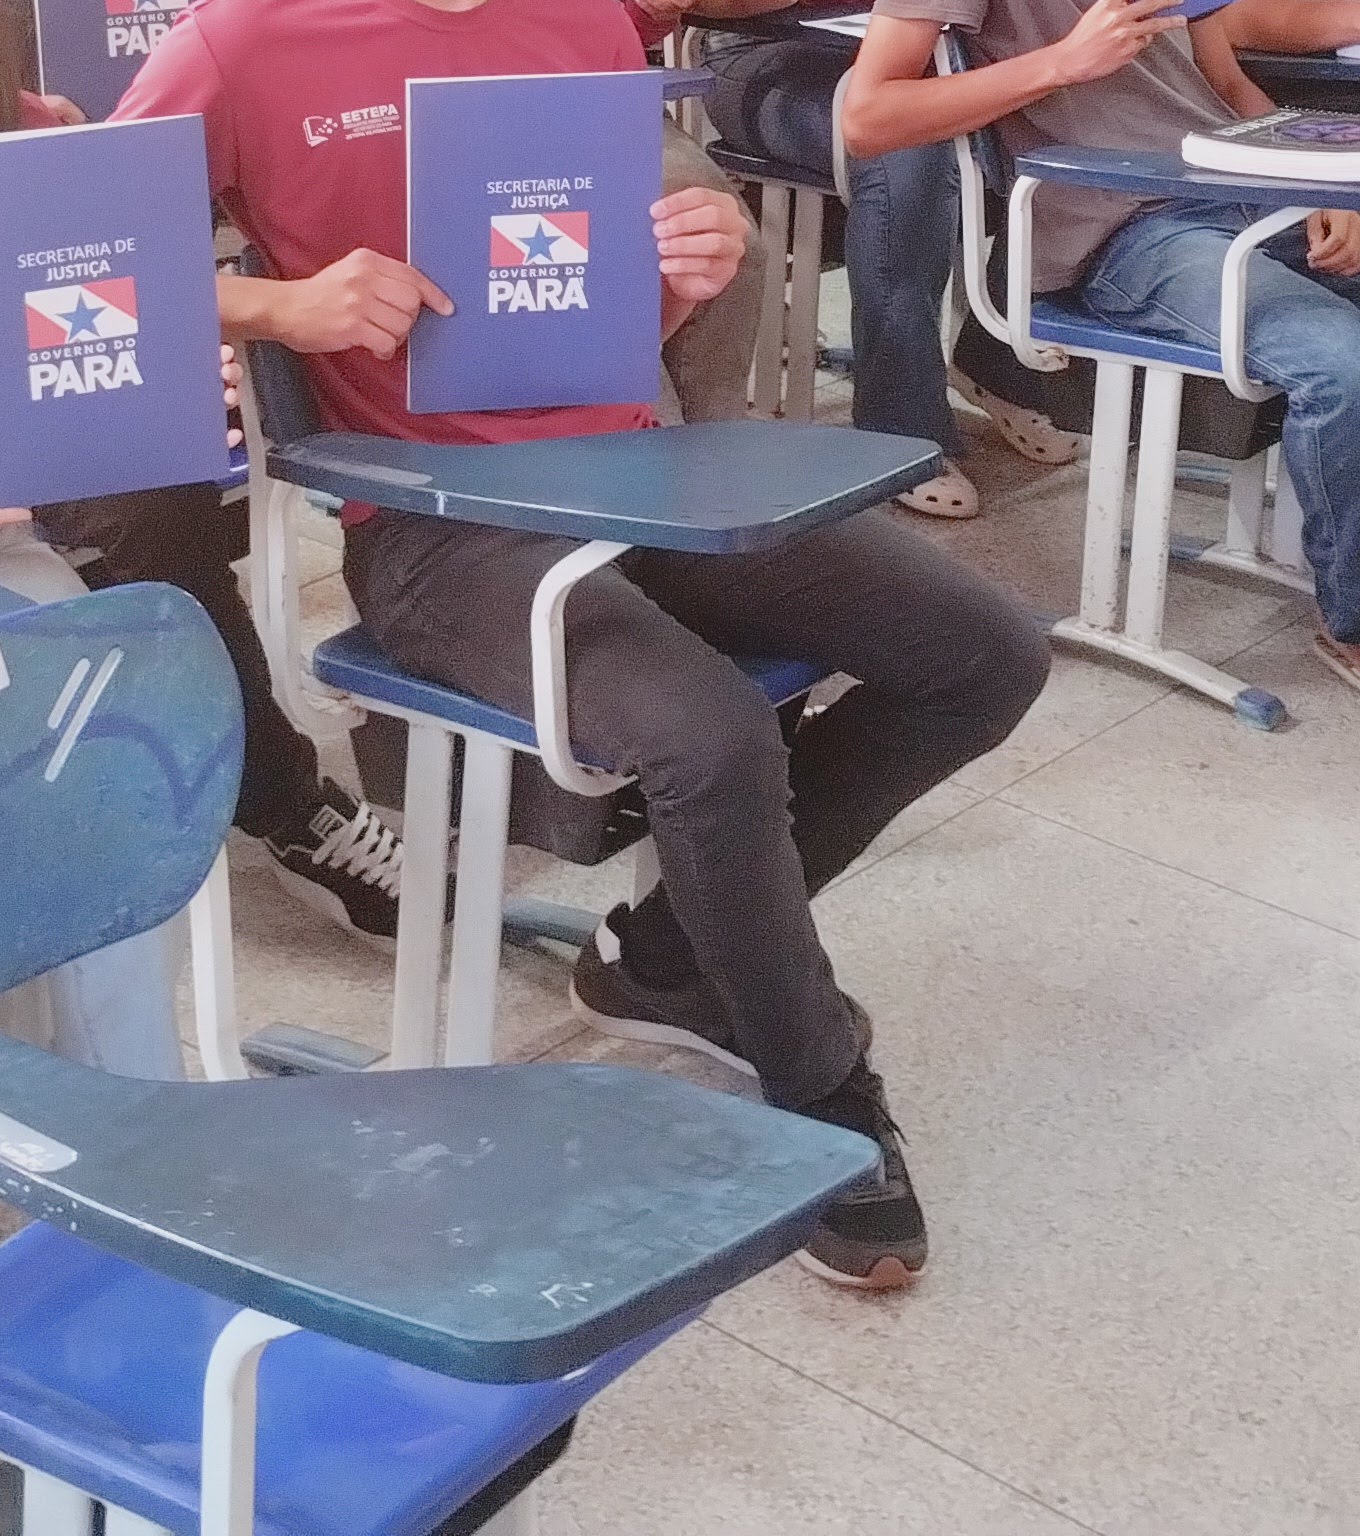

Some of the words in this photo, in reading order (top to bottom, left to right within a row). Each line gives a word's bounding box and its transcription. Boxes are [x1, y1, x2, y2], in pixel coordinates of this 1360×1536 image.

[106, 13, 166, 26] GOVERNO
[106, 23, 173, 58] PAR
[340, 104, 399, 124] EETEPA
[486, 179, 571, 194] SECRETARIA
[574, 177, 593, 191] DE
[511, 193, 569, 210] JUSTIÇA
[17, 242, 111, 270] SECRETARIA
[114, 237, 136, 253] DE
[45, 259, 112, 282] JUSTIÇA
[488, 267, 558, 279] GOVERNO
[564, 266, 585, 275] DO
[27, 342, 106, 363] GOVERNO
[113, 338, 136, 350] DO
